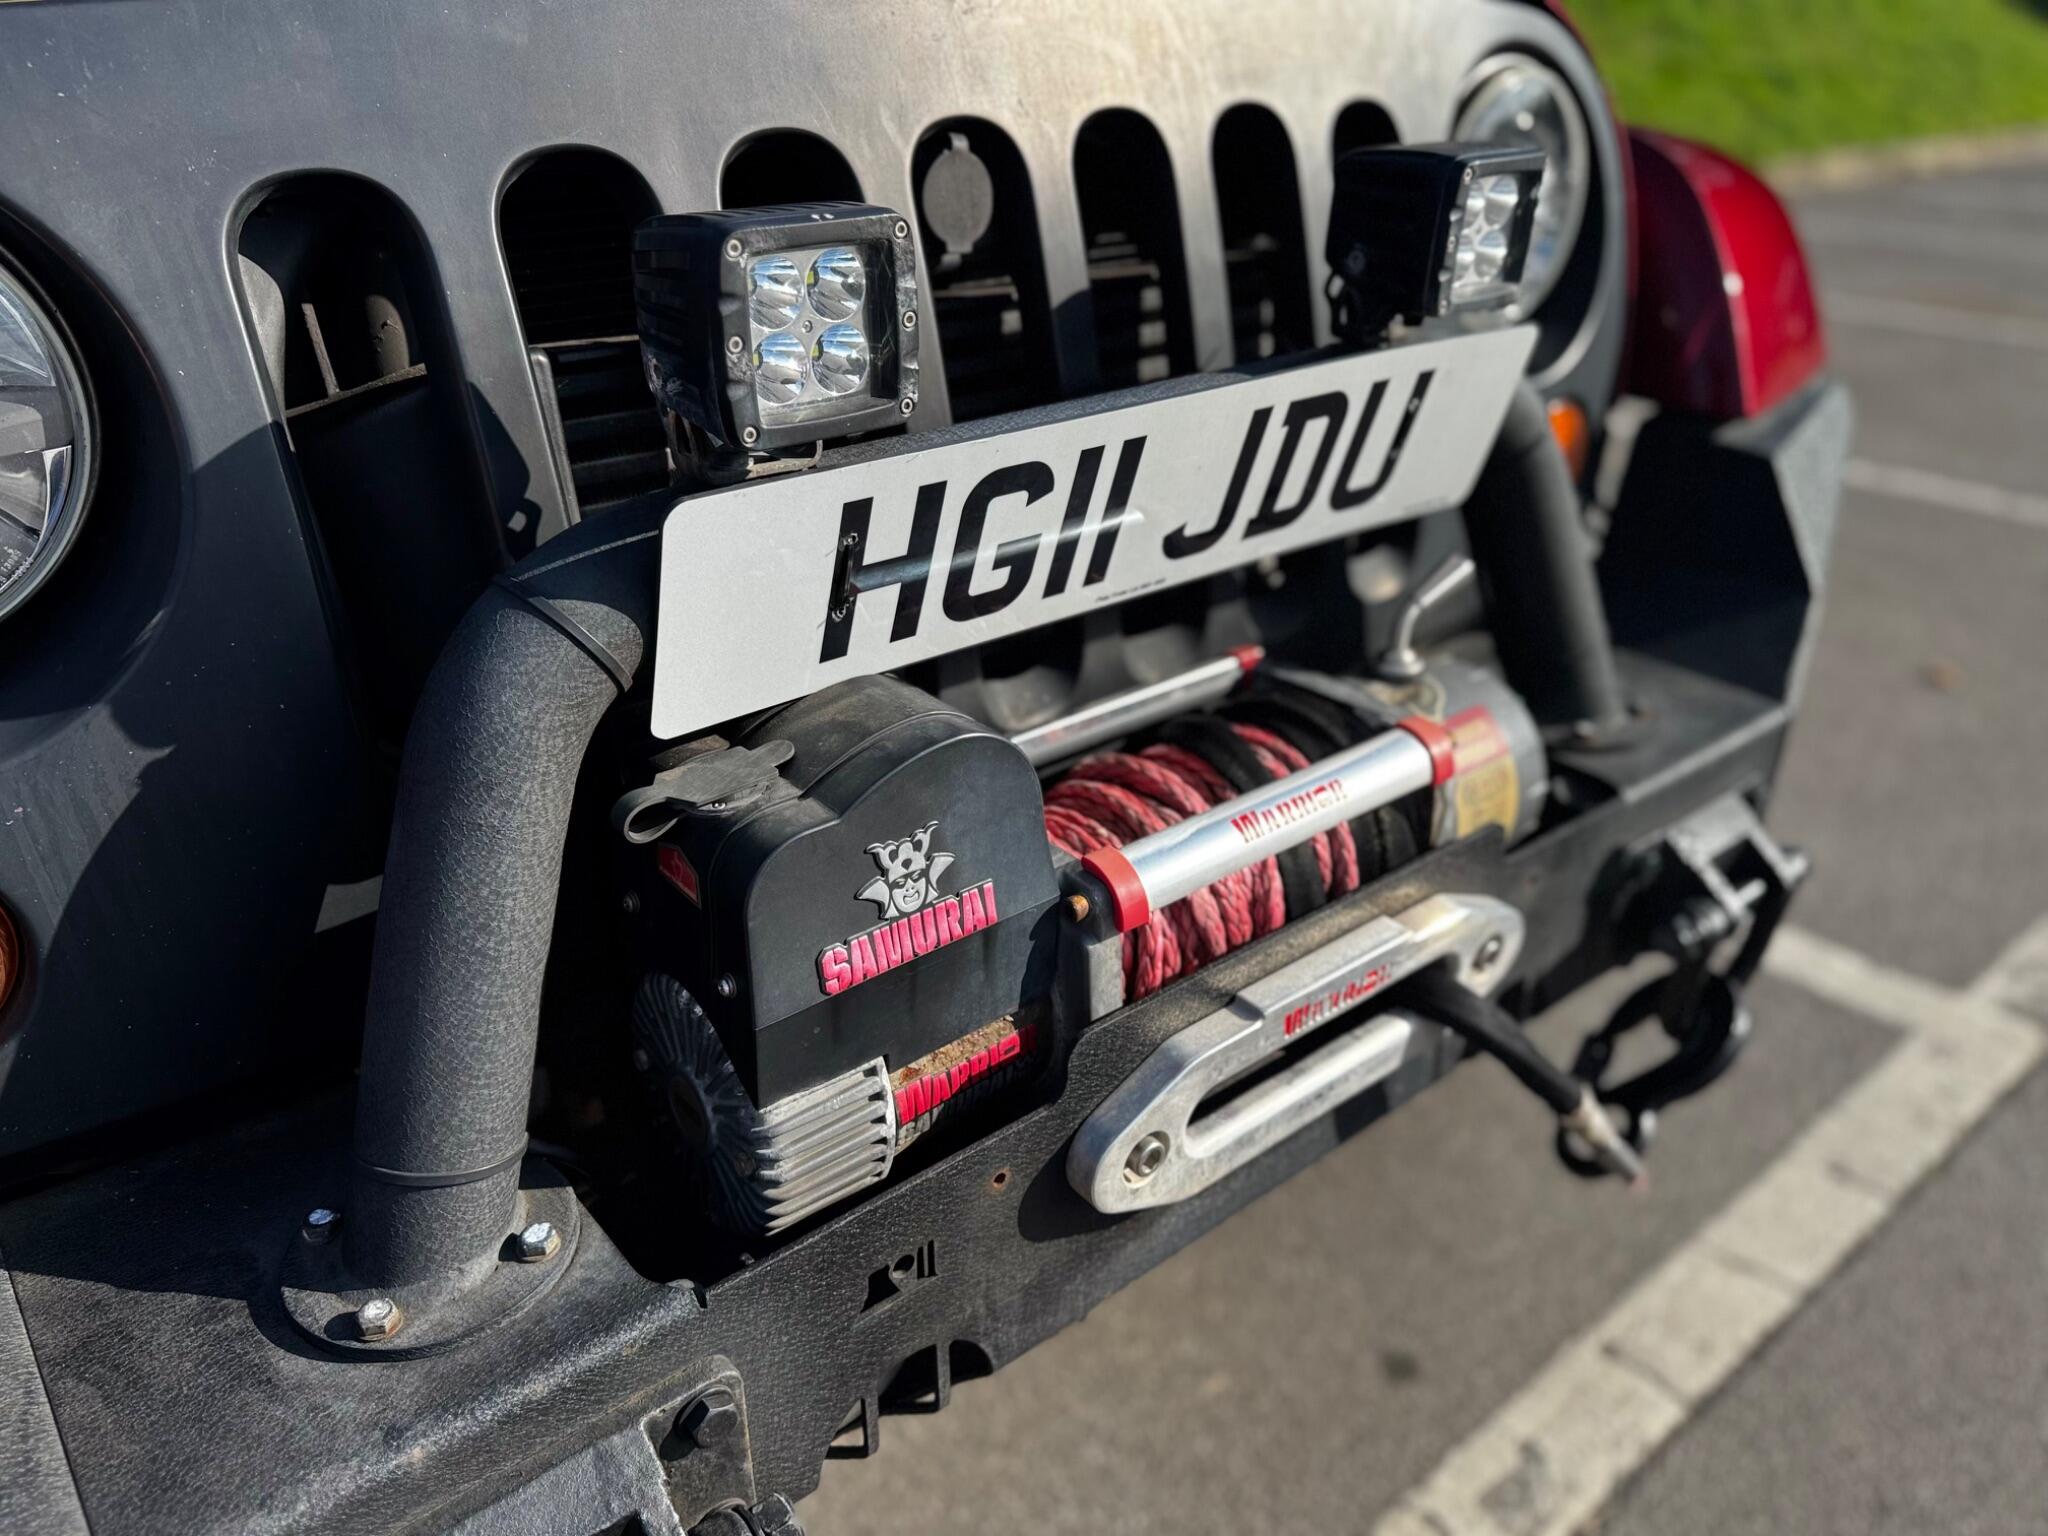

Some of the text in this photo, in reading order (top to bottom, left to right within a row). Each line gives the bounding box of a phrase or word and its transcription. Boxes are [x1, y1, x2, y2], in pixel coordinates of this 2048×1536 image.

[819, 369, 1435, 665] HG11 JDU
[820, 886, 998, 997] SAMURAI
